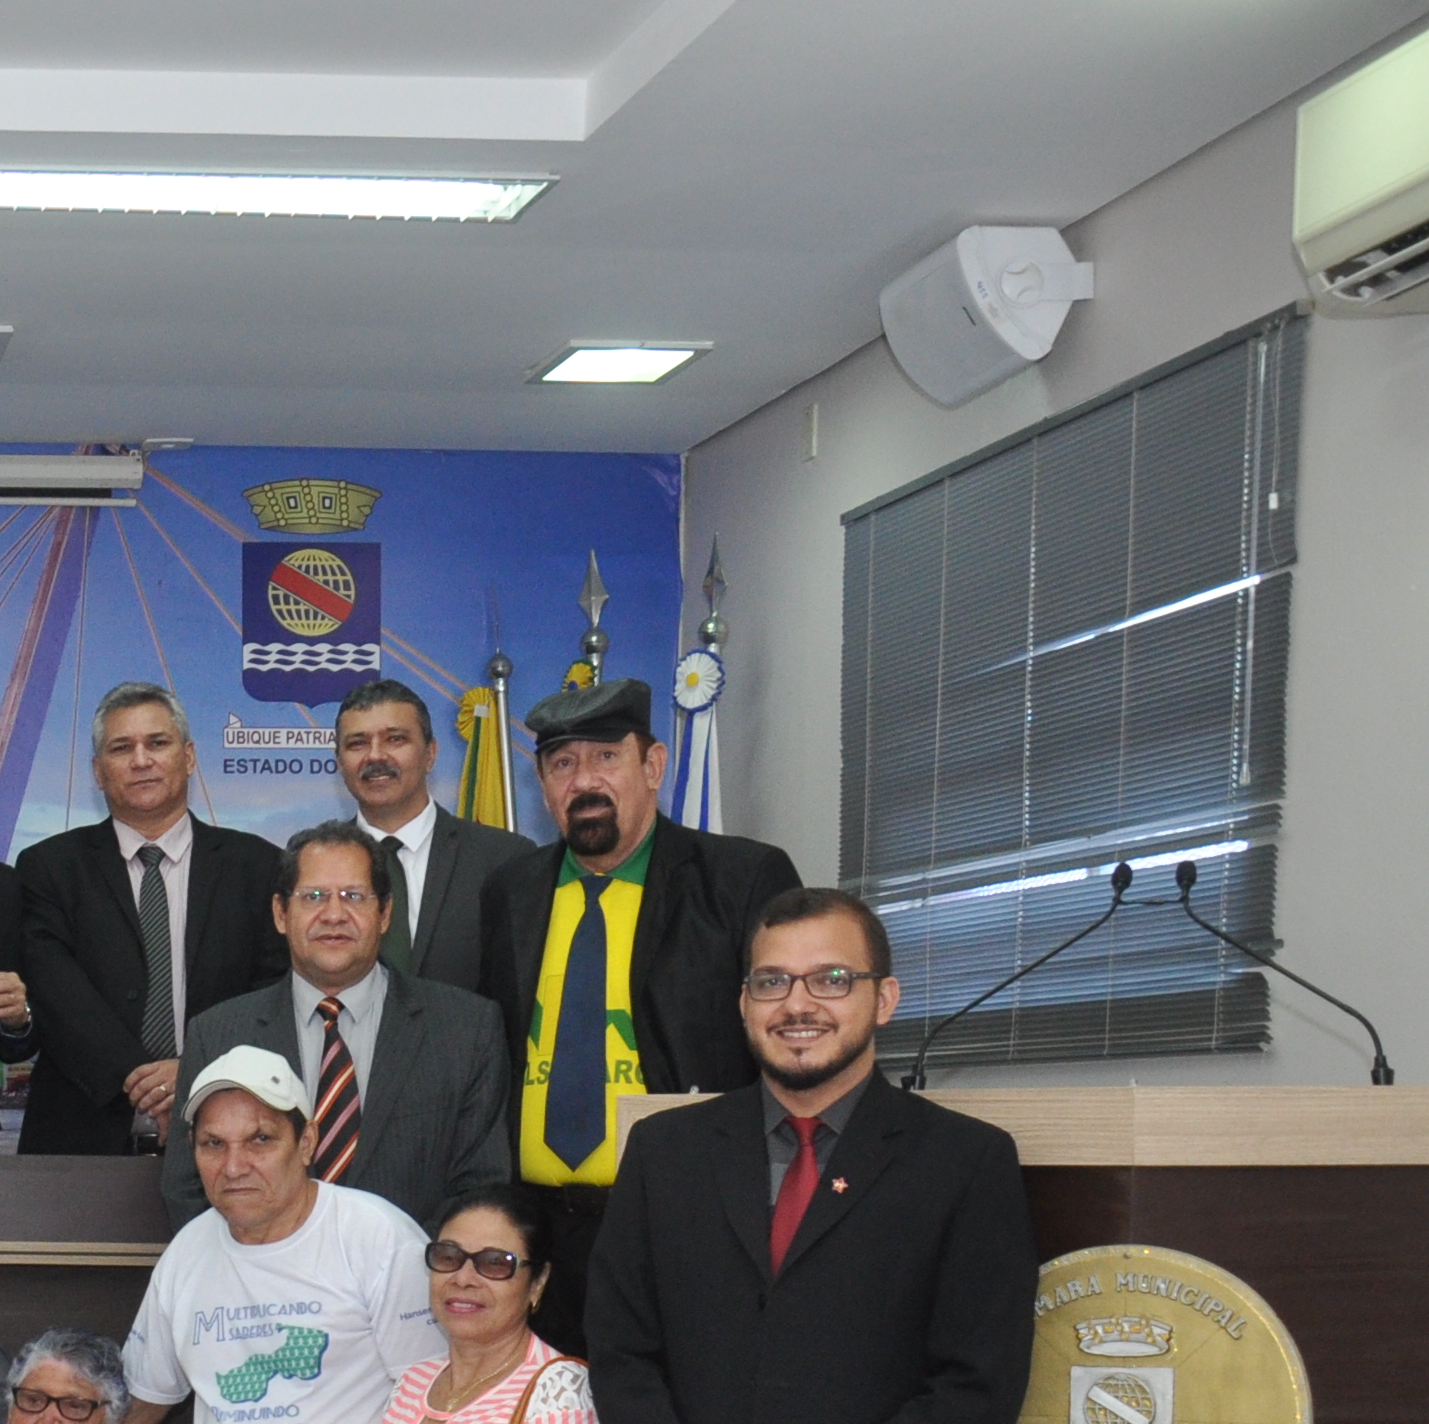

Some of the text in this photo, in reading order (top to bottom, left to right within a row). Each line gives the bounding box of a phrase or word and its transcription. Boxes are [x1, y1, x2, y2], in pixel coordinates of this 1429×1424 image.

[225, 730, 282, 746] UBIQUE
[222, 758, 339, 775] ESTADO DO
[1115, 1271, 1249, 1341] MUNICIPAL
[228, 1322, 274, 1341] SABERES
